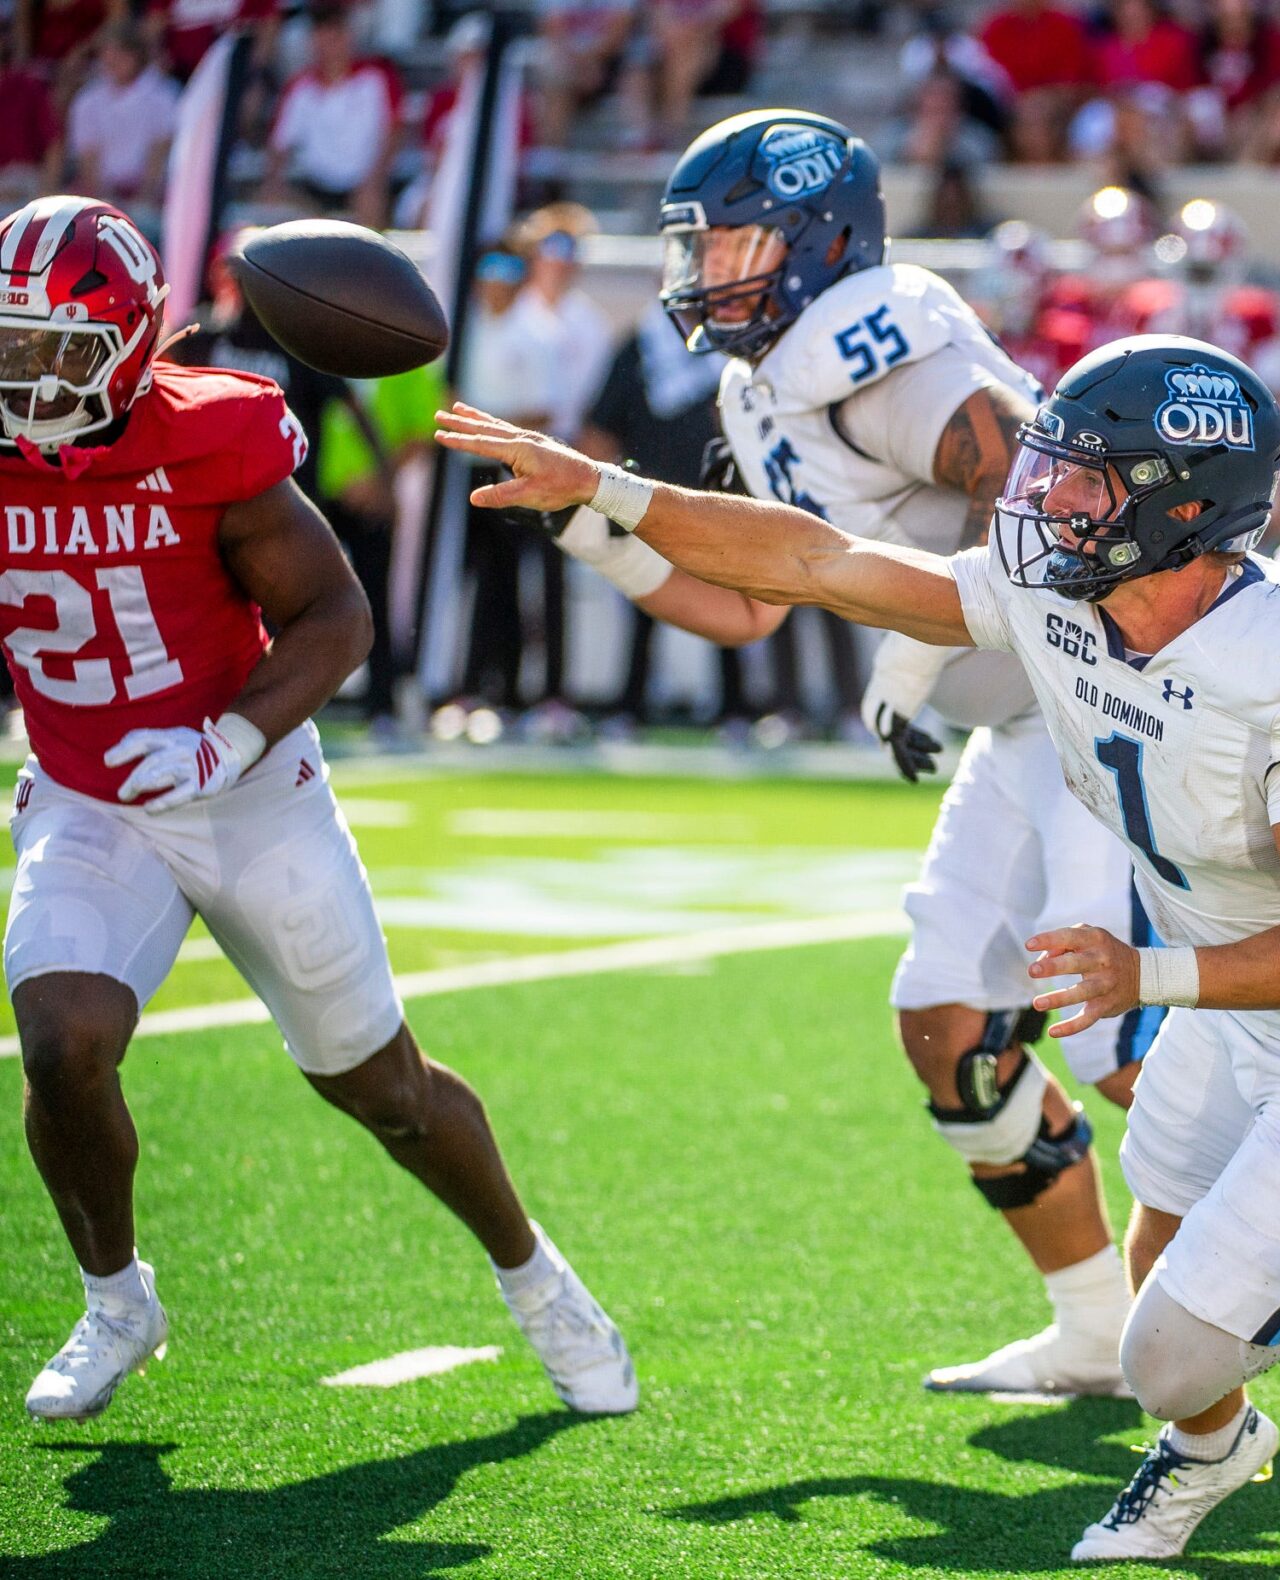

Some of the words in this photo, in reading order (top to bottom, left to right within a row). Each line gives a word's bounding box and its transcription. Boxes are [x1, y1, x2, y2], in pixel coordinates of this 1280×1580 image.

[835, 304, 911, 384] 55
[1072, 439, 1108, 454] OAKLEY
[1161, 403, 1251, 445] ODU
[0, 565, 184, 707] 21
[1046, 612, 1097, 666] SBC
[1075, 676, 1099, 708] OLD
[1101, 692, 1165, 742] DOMINION
[1094, 730, 1190, 892] 1
